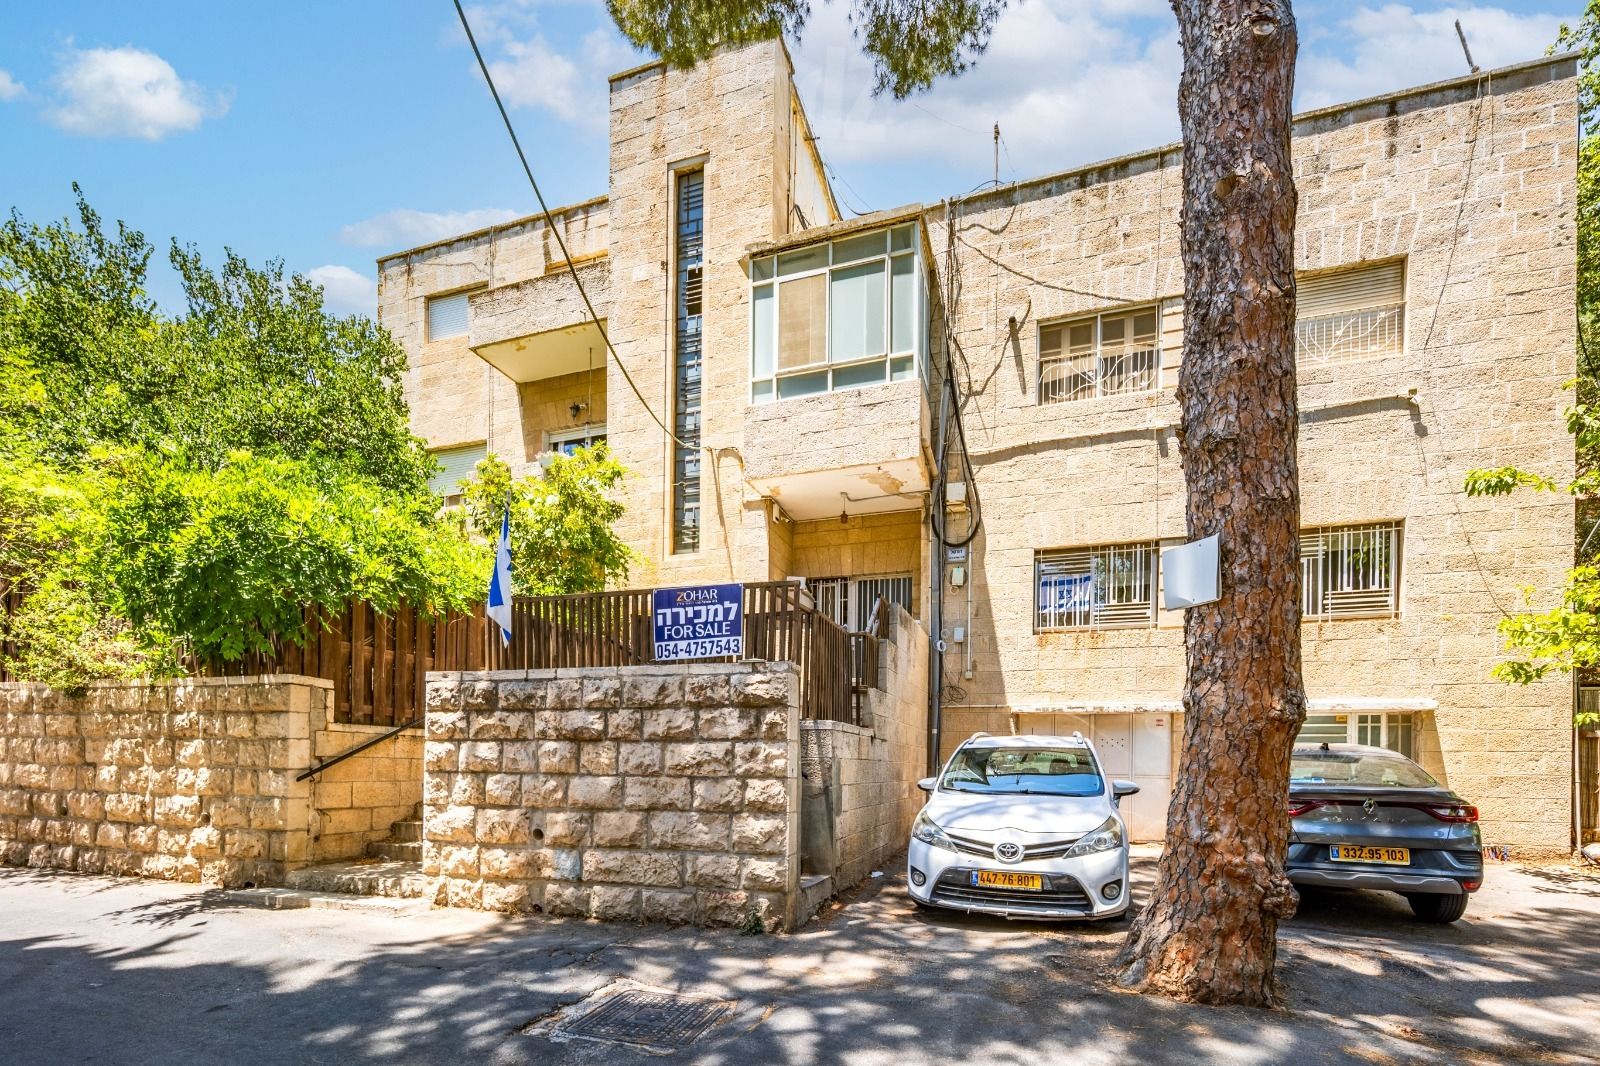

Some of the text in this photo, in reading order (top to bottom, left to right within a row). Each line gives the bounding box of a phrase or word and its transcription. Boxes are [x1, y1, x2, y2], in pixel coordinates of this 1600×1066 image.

[677, 588, 718, 602] ZOHAR
[657, 601, 739, 627] למכירה
[664, 621, 731, 640] FOR SALE
[656, 638, 740, 659] 054-4757543
